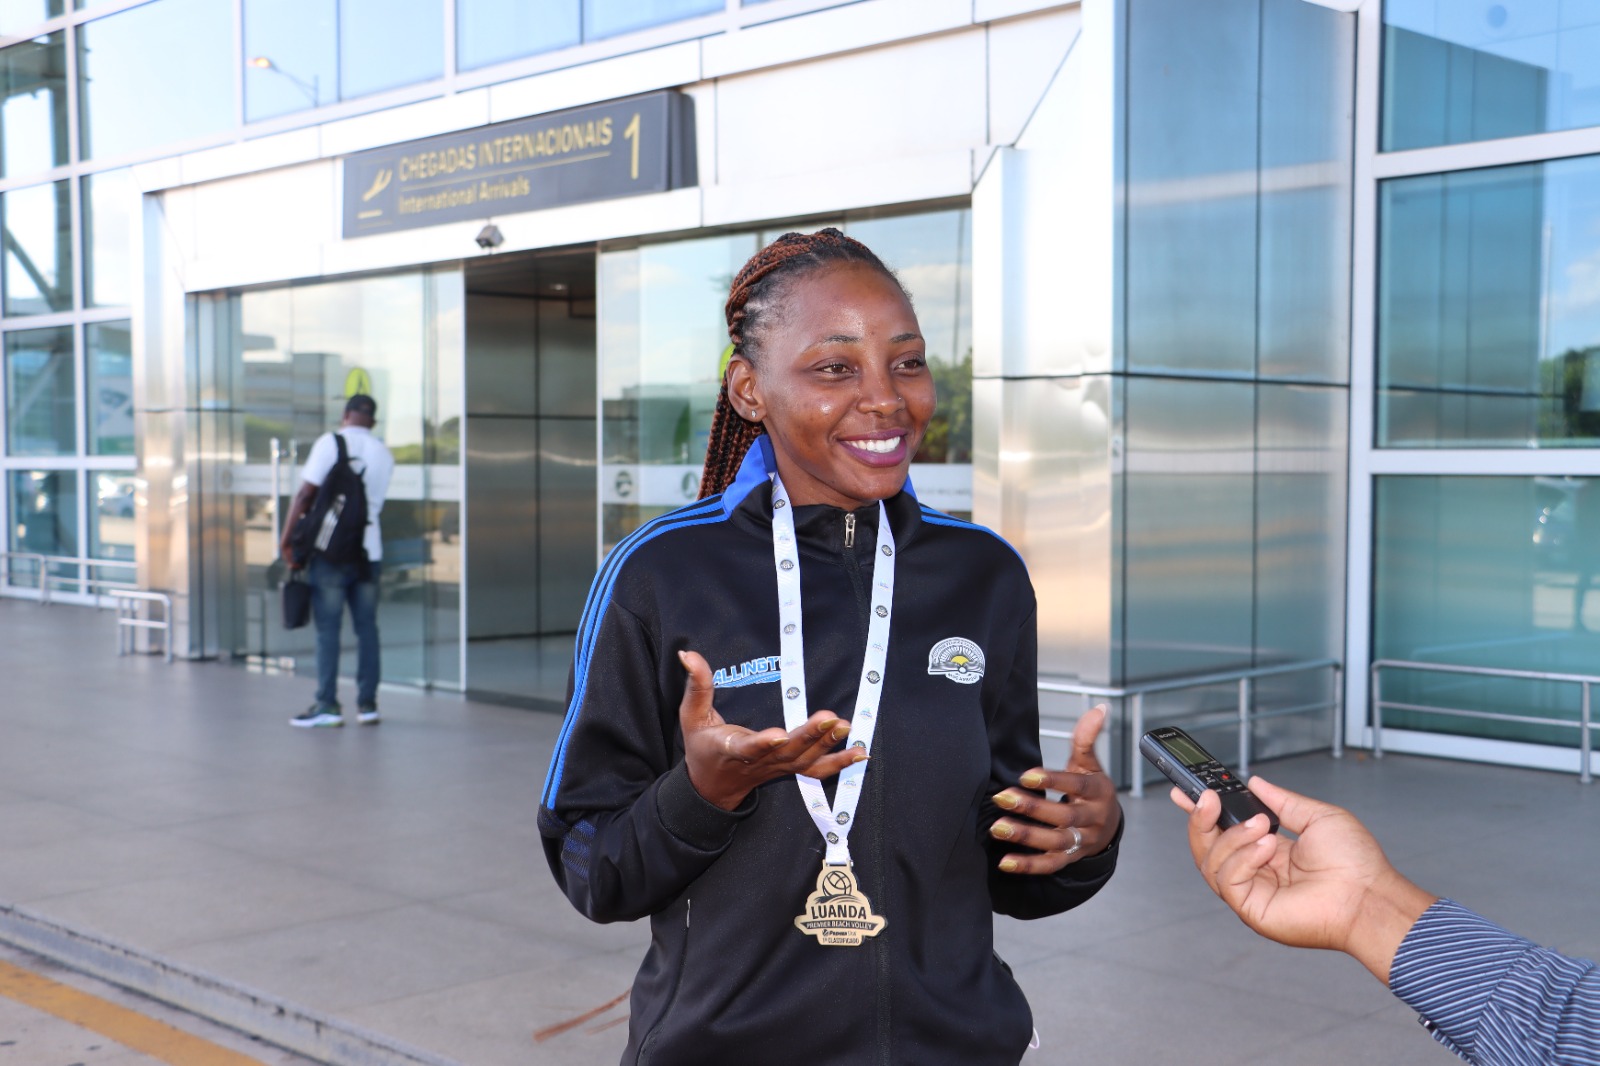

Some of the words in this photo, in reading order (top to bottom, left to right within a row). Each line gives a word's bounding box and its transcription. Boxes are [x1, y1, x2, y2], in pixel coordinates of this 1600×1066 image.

[400, 143, 476, 181] CHEGADAS
[479, 116, 613, 167] INTERNACIONAIS
[623, 112, 641, 180] 1
[399, 184, 477, 214] International
[479, 174, 531, 200] Arrivals
[712, 656, 781, 685] ALLINGT
[806, 921, 831, 929] PREMIER
[831, 919, 851, 928] BEACH
[851, 921, 872, 930] VOLLEY
[810, 904, 867, 919] LUANDA
